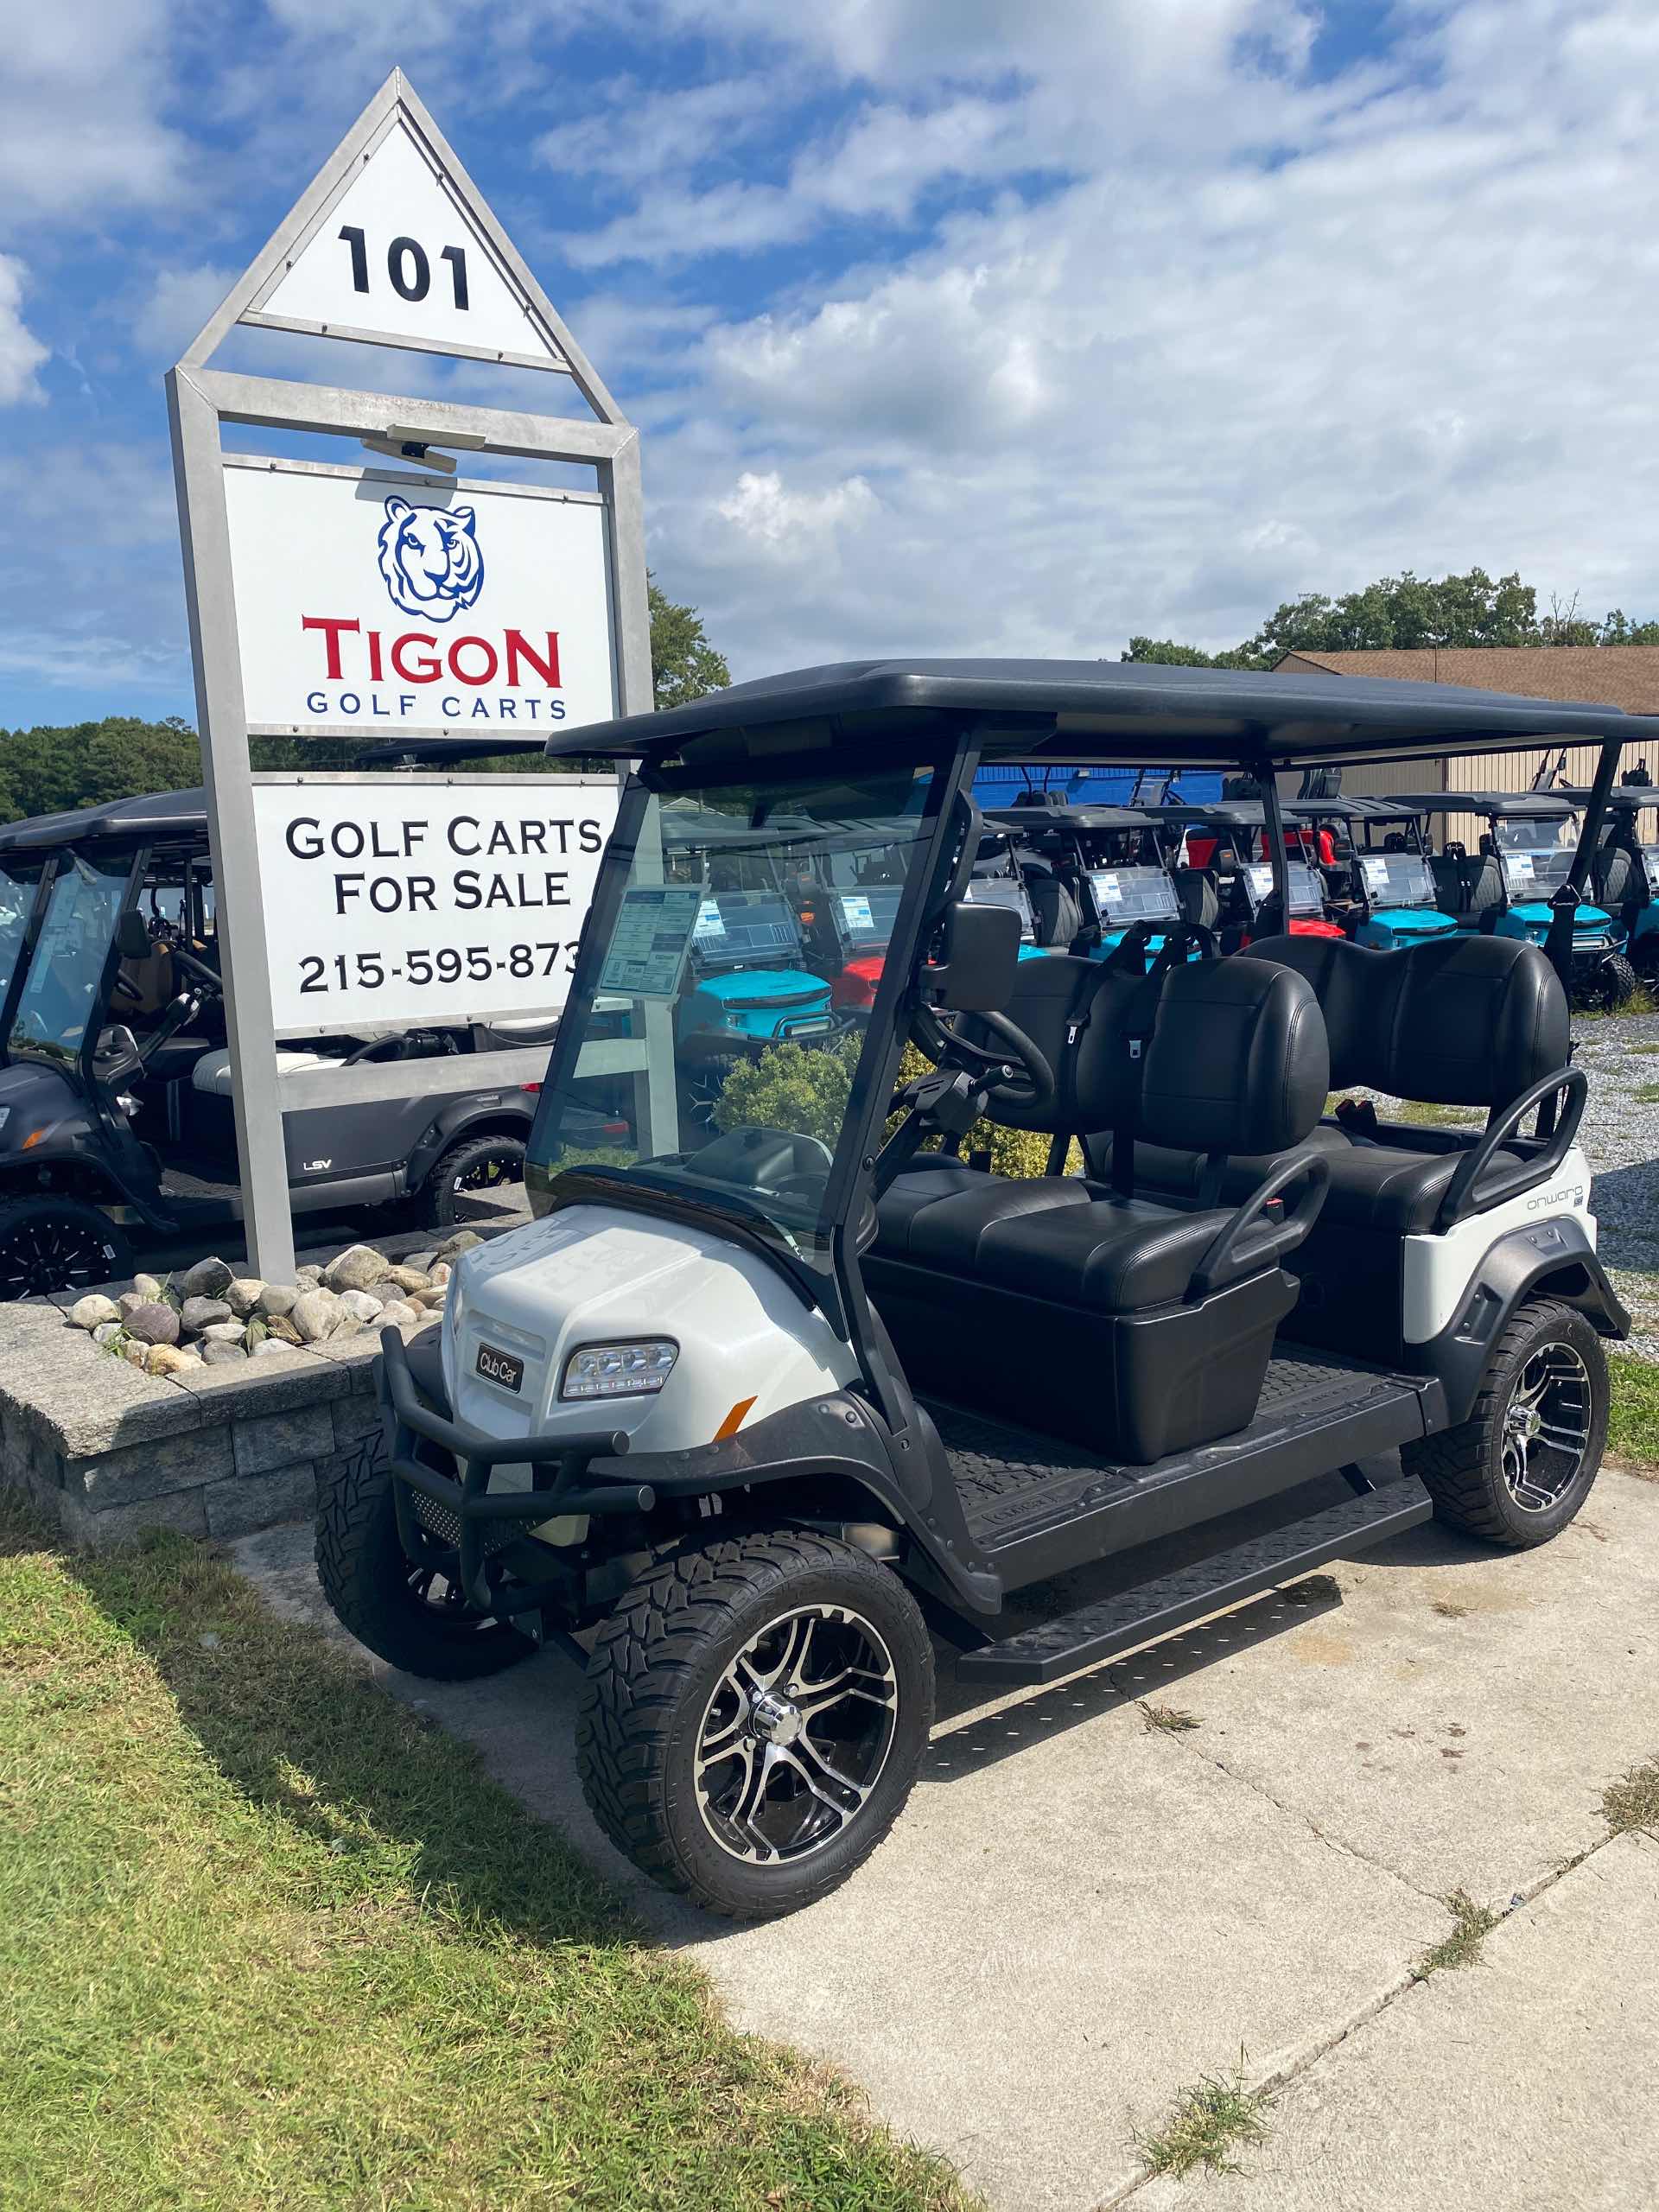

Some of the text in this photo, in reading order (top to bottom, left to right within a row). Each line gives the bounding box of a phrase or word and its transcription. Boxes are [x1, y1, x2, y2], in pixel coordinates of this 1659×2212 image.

[338, 225, 470, 312] 101
[302, 615, 563, 689] TIGON
[307, 692, 566, 720] GOLF CARTS
[286, 816, 602, 859] GOLF CARTS
[334, 869, 571, 914] FOR SALE
[303, 1159, 332, 1171] LSV
